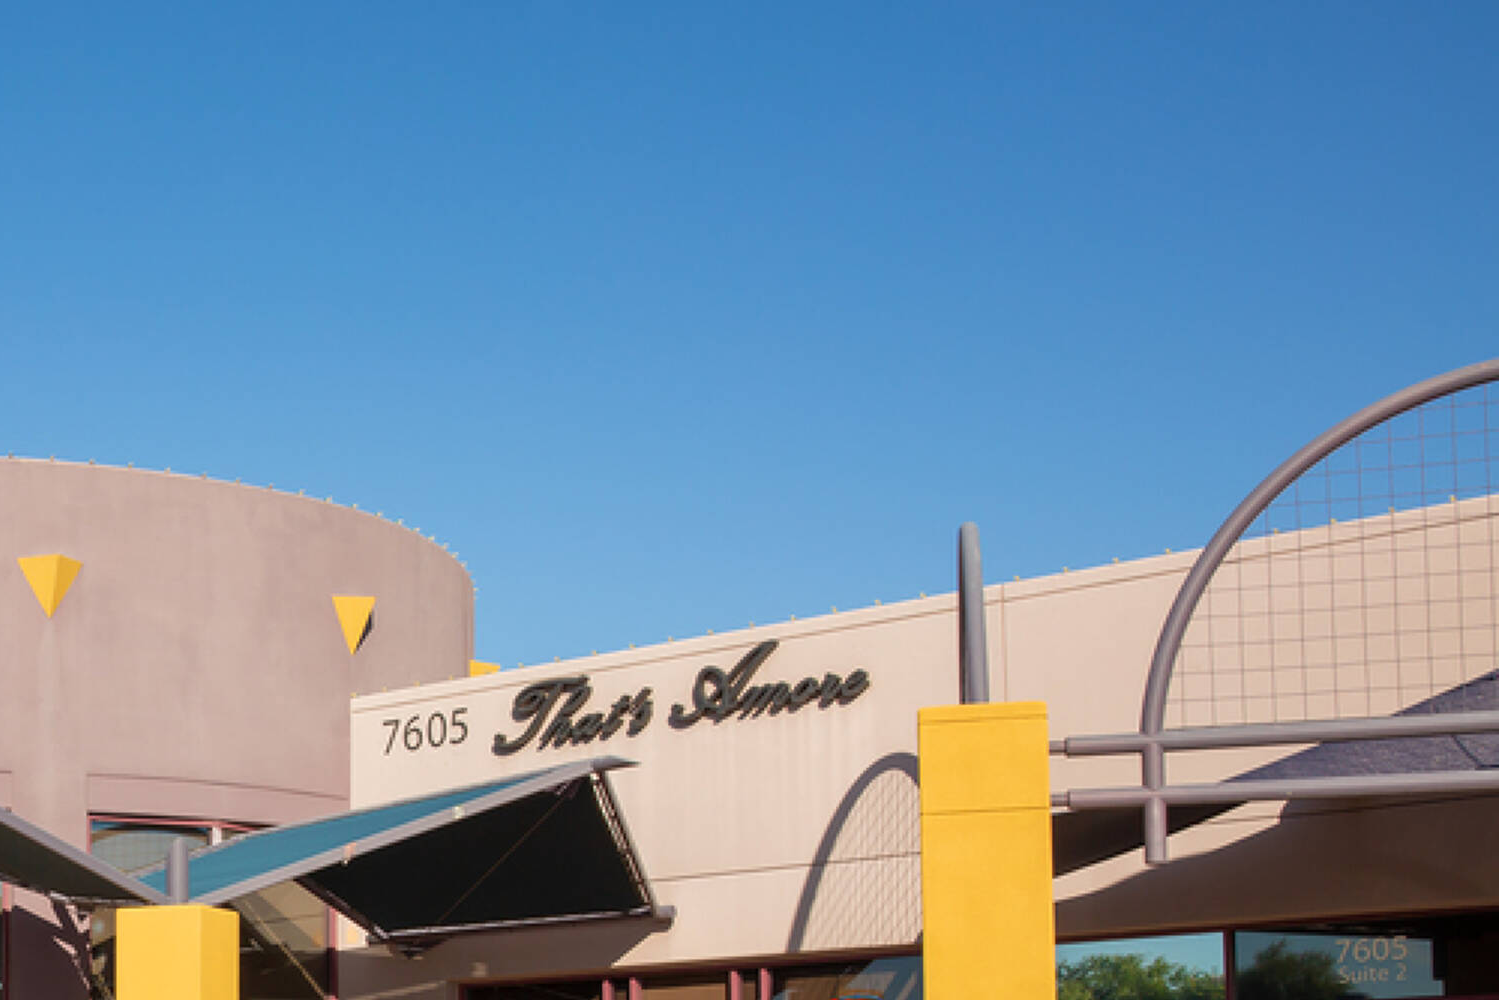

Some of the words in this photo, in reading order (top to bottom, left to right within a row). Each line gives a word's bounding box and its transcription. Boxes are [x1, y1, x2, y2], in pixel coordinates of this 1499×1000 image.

[491, 674, 653, 756] That's
[668, 638, 870, 729] Amore
[382, 707, 468, 755] 7605
[1335, 935, 1408, 963] 7605
[1338, 965, 1389, 985] Suite
[1396, 962, 1407, 982] 2
